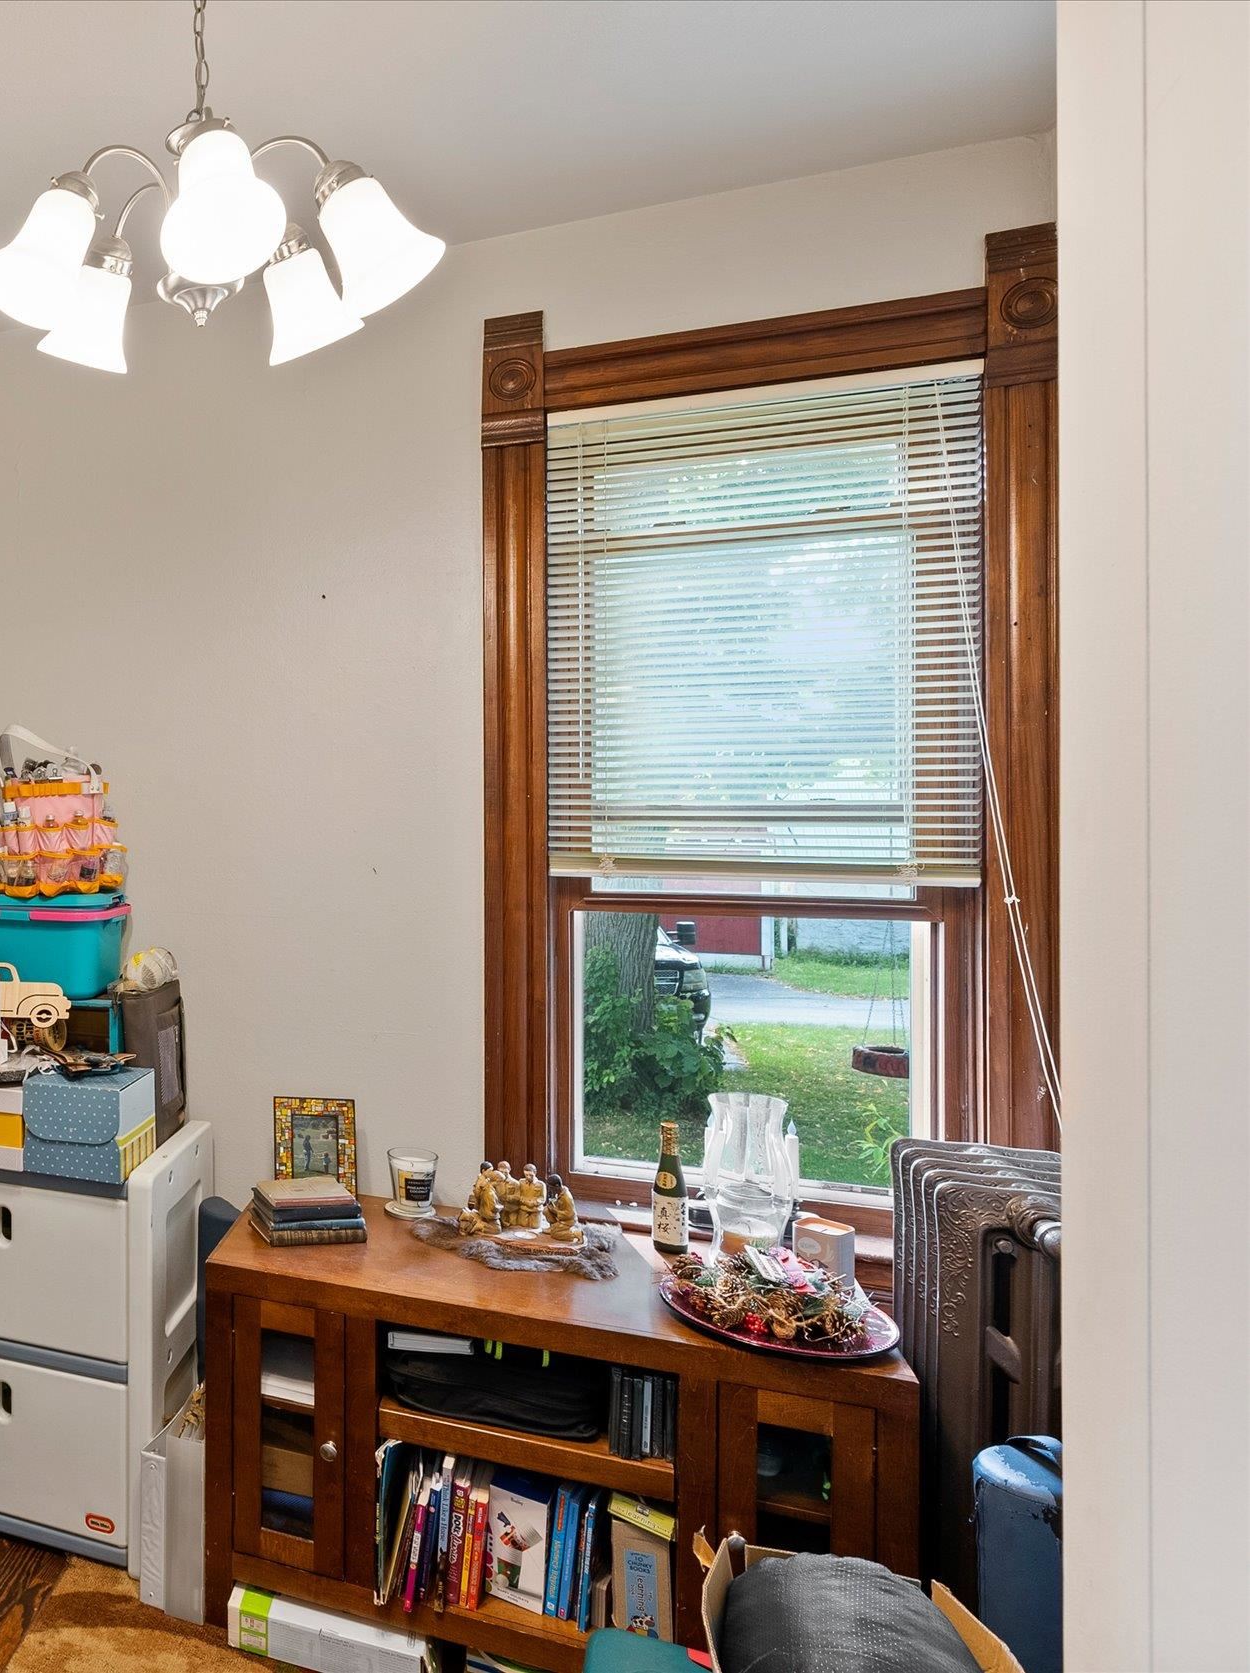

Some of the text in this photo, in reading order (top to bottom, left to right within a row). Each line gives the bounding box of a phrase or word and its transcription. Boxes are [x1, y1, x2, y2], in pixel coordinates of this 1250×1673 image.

[441, 1482, 451, 1499] Think
[440, 1500, 449, 1514] Like
[438, 1519, 448, 1539] Horse
[452, 1513, 463, 1536] DORK
[636, 1575, 645, 1613] learning
